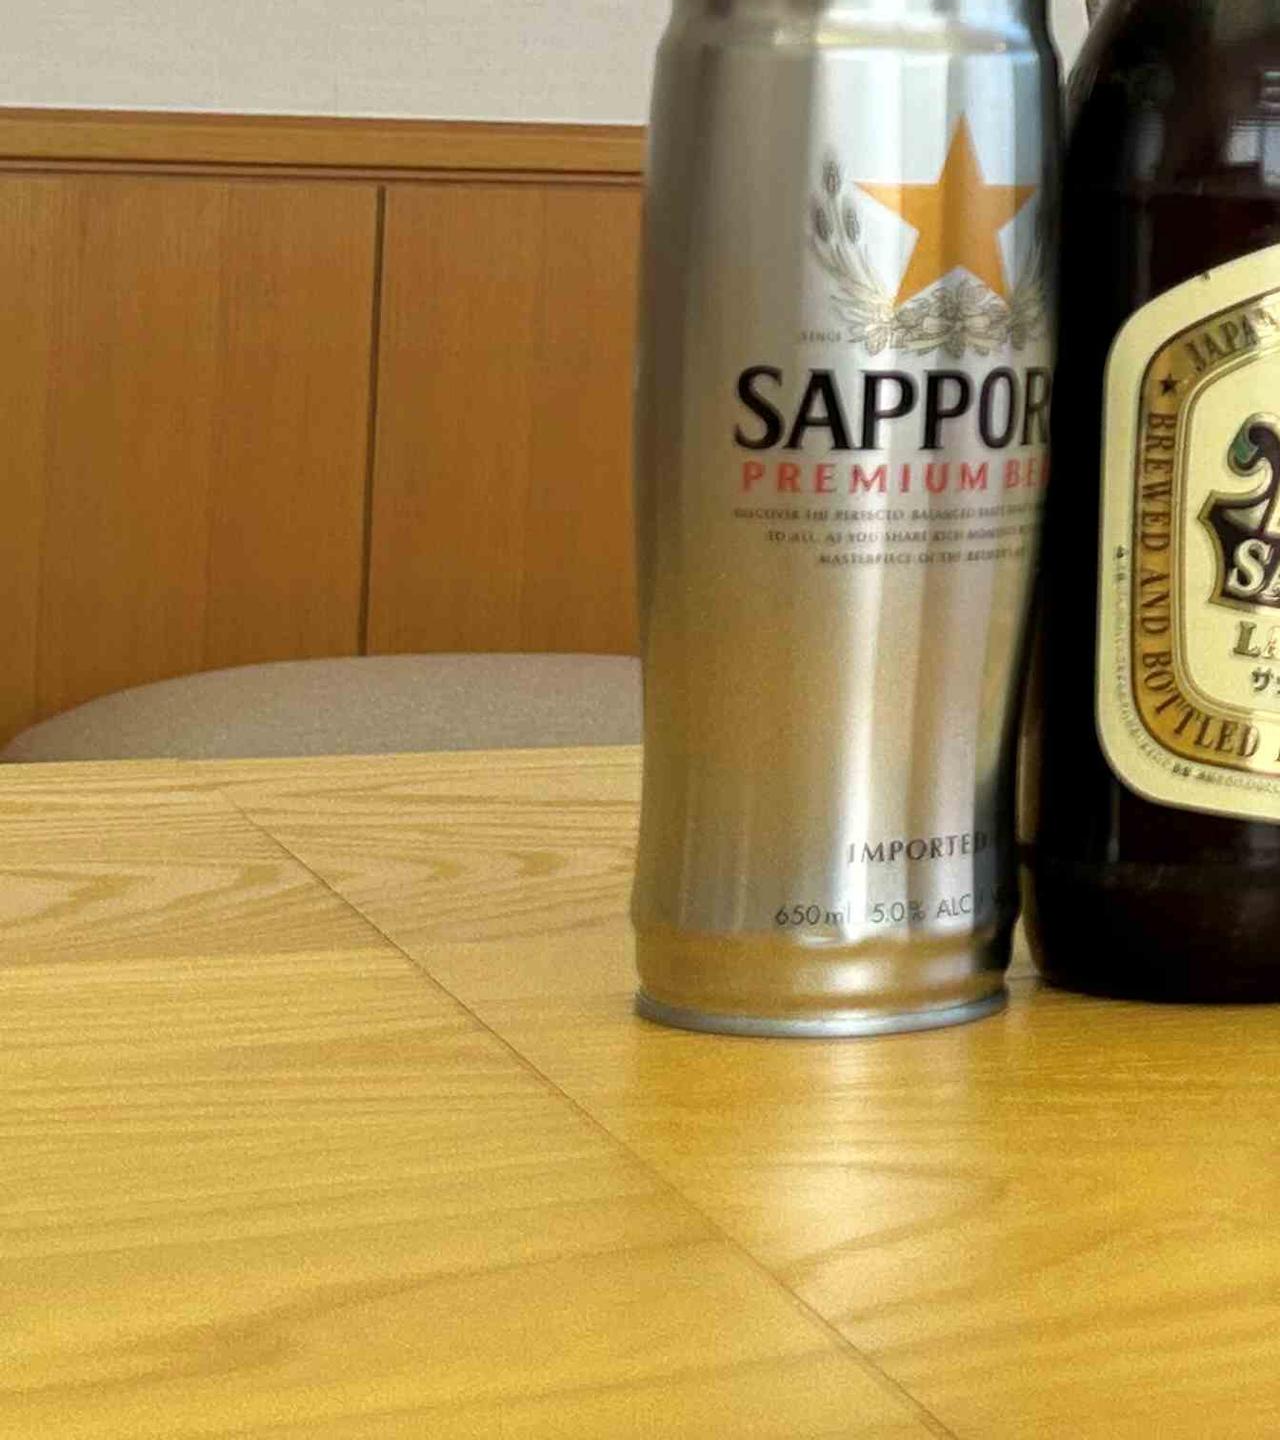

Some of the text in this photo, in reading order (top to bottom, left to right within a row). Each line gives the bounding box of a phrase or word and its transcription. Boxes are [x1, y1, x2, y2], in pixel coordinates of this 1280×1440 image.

[739, 460, 989, 495] PREMIUM
[1140, 411, 1176, 552] BREWED
[1140, 568, 1171, 635] AND
[1142, 650, 1259, 760] BOTTLED
[849, 831, 988, 864] IMPORTED
